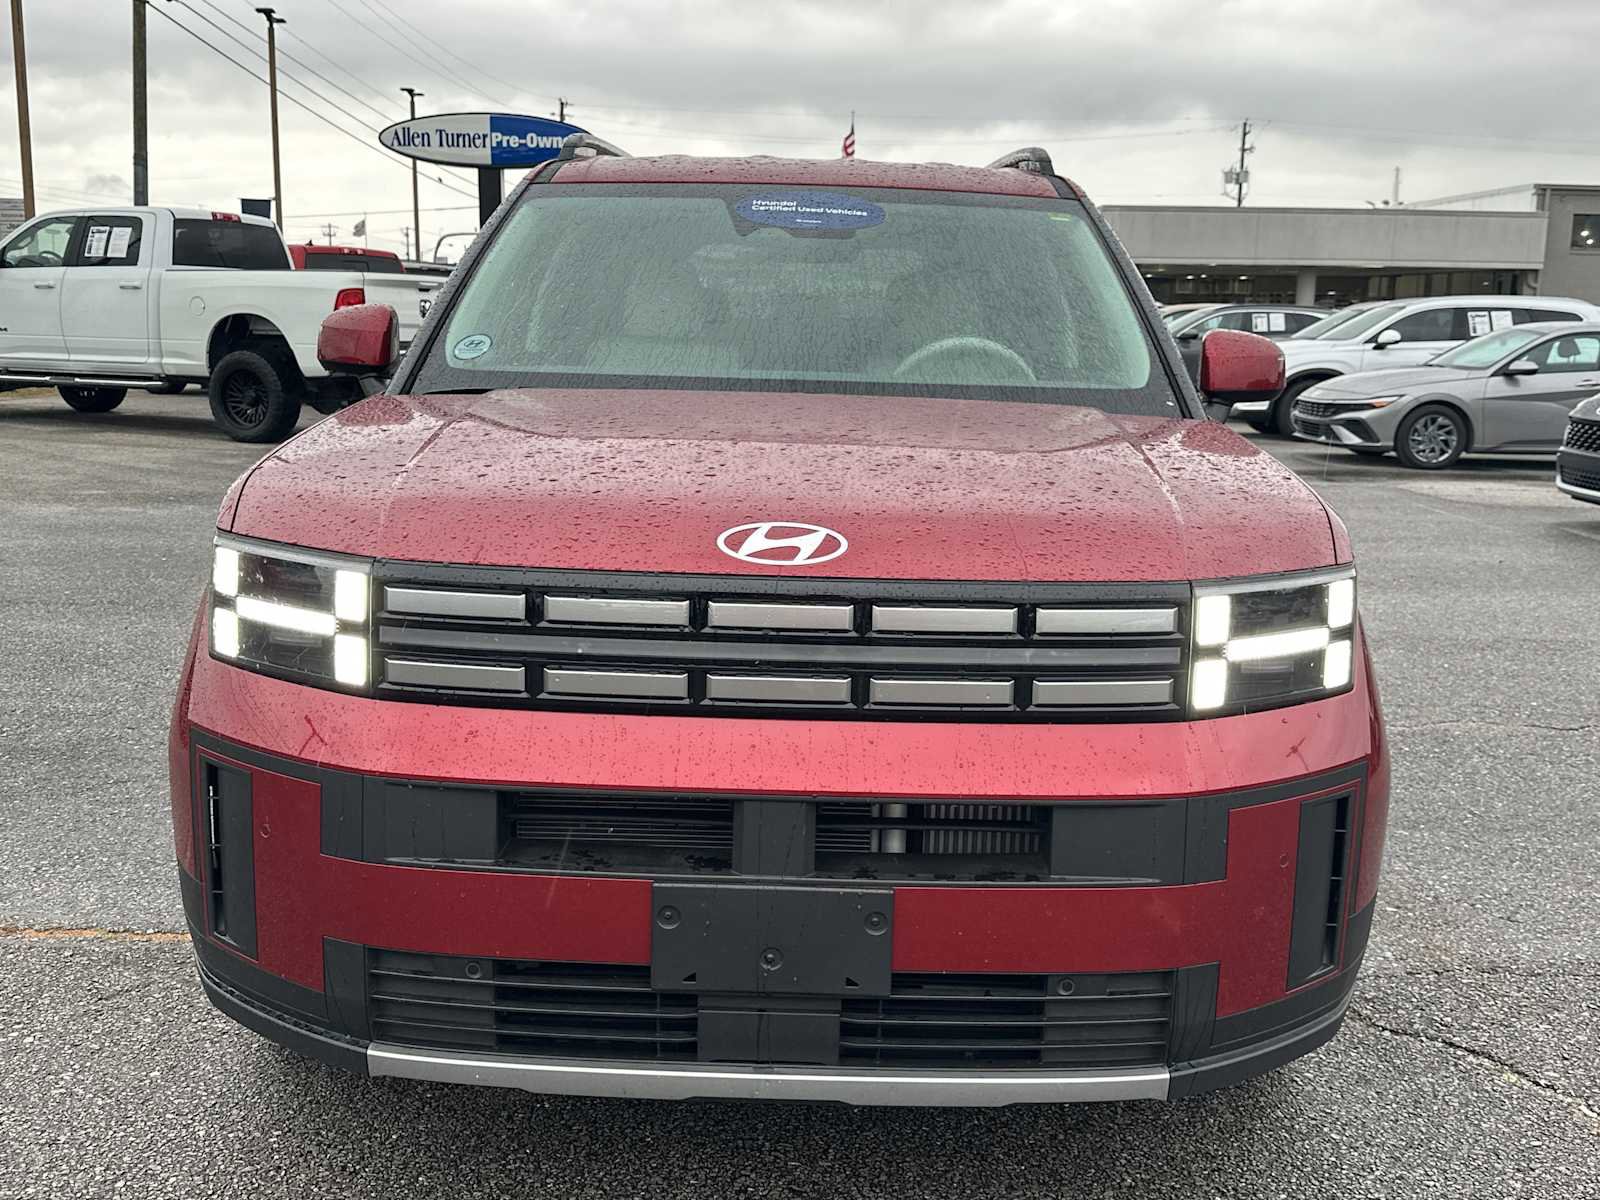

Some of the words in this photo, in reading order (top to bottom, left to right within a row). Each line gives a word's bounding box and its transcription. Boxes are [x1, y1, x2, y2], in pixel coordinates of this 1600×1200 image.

[390, 127, 431, 148] Allen
[435, 129, 488, 149] Turner
[825, 208, 868, 216] Vehicles
